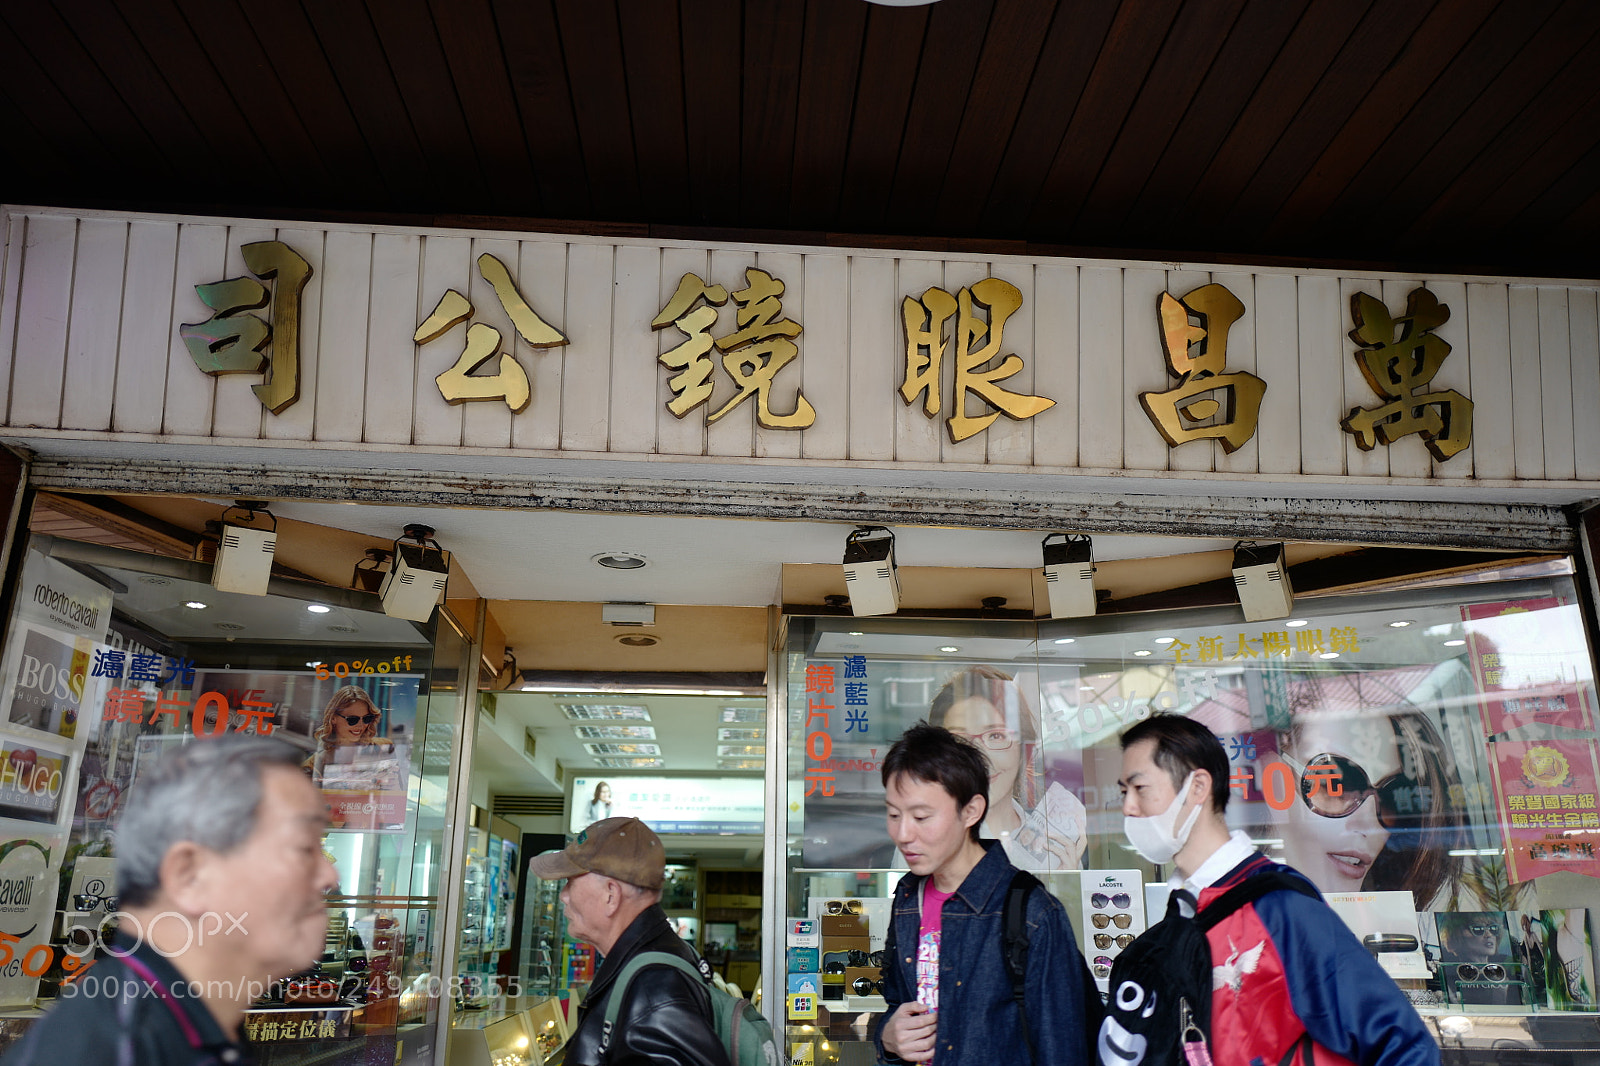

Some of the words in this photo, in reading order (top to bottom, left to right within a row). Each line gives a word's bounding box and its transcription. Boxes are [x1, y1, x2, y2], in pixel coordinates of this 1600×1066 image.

[33, 584, 70, 616] roberto
[69, 600, 99, 630] cavalli
[91, 648, 196, 685] 濾藍光
[1165, 626, 1361, 665] 全新太陽眼鏡
[18, 654, 84, 705] BOSS
[844, 655, 869, 733] 濾藍光
[102, 686, 276, 741] 鏡片0元
[804, 664, 836, 797] 鏡片0元
[0, 759, 63, 800] HUGO
[1507, 793, 1597, 811] 榮登國家級
[0, 875, 34, 906] avalli
